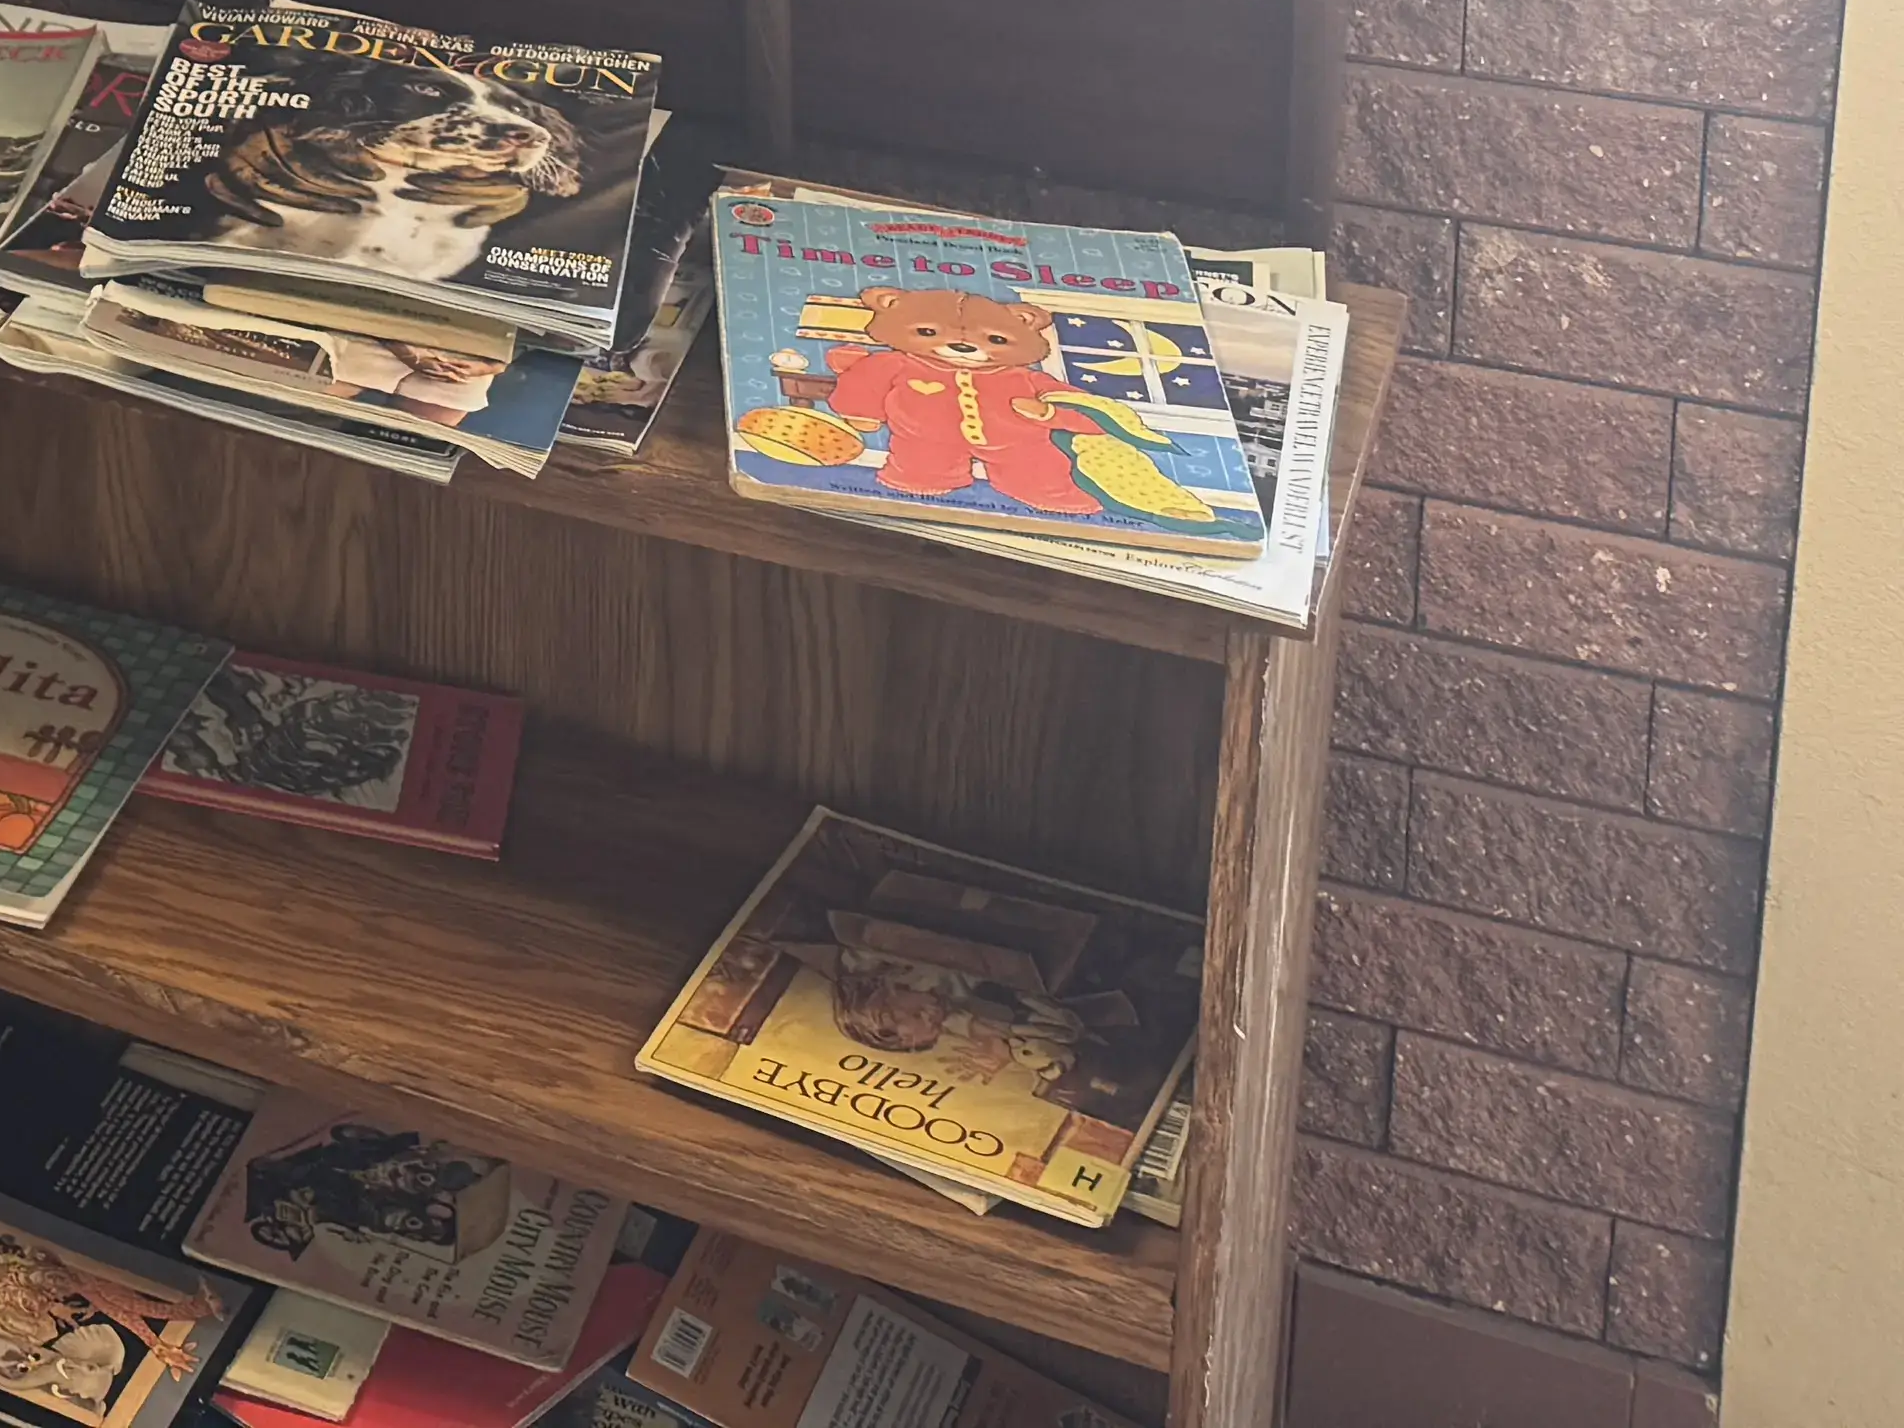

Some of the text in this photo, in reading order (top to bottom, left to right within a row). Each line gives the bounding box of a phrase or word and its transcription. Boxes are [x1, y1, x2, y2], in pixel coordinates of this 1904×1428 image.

[201, 10, 330, 29] VIVIAN HOWARD
[420, 35, 475, 53] TEXAS
[170, 57, 245, 80] BEST
[190, 22, 642, 94] GARDEN GUN
[490, 45, 650, 71] OUTDOOR KITCHEN
[165, 71, 268, 94] OF THE
[153, 96, 256, 120] SOUTH
[158, 84, 311, 110] SPORTING
[486, 254, 609, 283] CONSERVATION
[491, 247, 611, 273] CHAMPIONS OF
[729, 231, 896, 268] Time
[911, 255, 976, 276] to
[989, 259, 1181, 300] Sleep
[1292, 325, 1331, 448] EXPERIENCE TRAVEL
[1124, 552, 1184, 571] Explore
[838, 1053, 956, 1109] hello
[756, 1055, 1005, 1159] GOOD-BYE
[471, 1208, 552, 1324] CITY MOUSE
[511, 1191, 610, 1349] COUNTRY MOUSE
